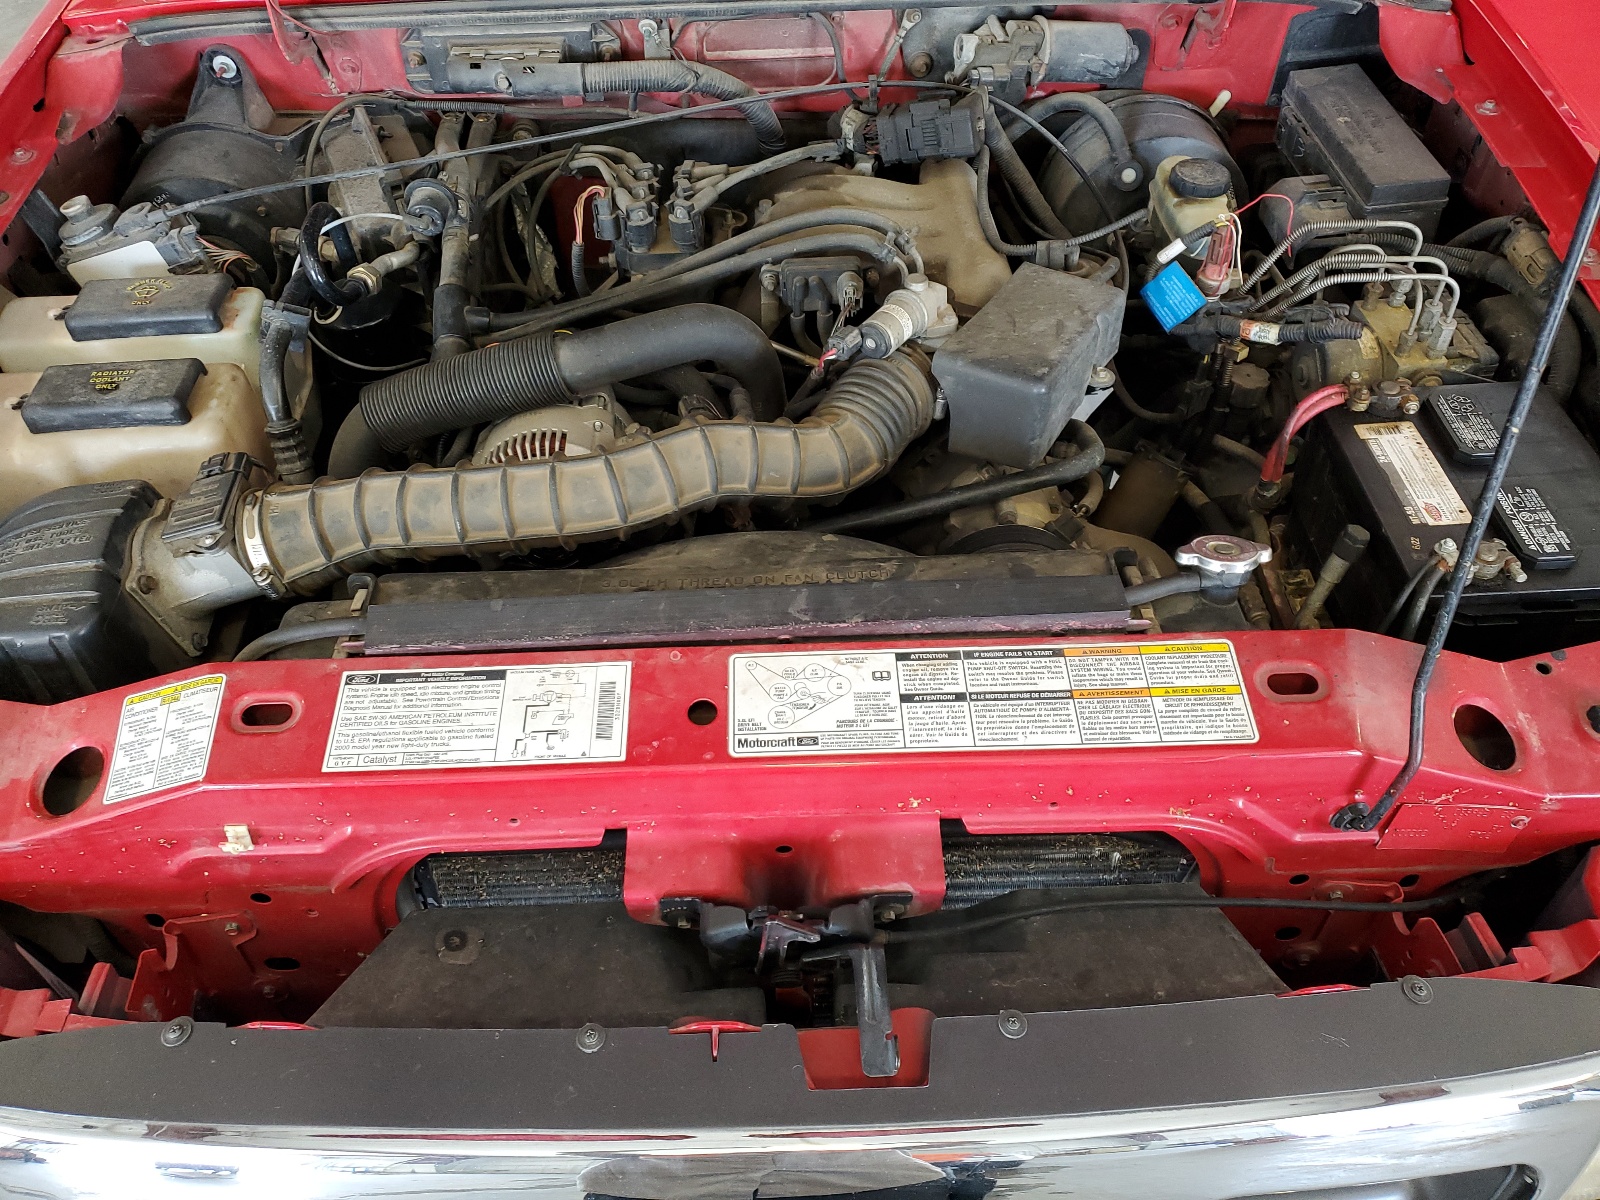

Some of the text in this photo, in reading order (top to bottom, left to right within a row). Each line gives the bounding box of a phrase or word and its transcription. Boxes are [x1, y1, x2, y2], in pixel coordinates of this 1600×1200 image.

[90, 369, 135, 377] RADIATOR
[1511, 519, 1533, 545] DANGER
[678, 576, 744, 589] THREAD
[753, 575, 775, 586] ON
[784, 572, 815, 584] FAN
[826, 569, 890, 581] CLUTCH
[1086, 689, 1144, 697] AVERTISSEMENT
[125, 707, 159, 719] CONDITIONER
[737, 736, 796, 749] Motorcraft
[362, 755, 397, 764] Catalyst
